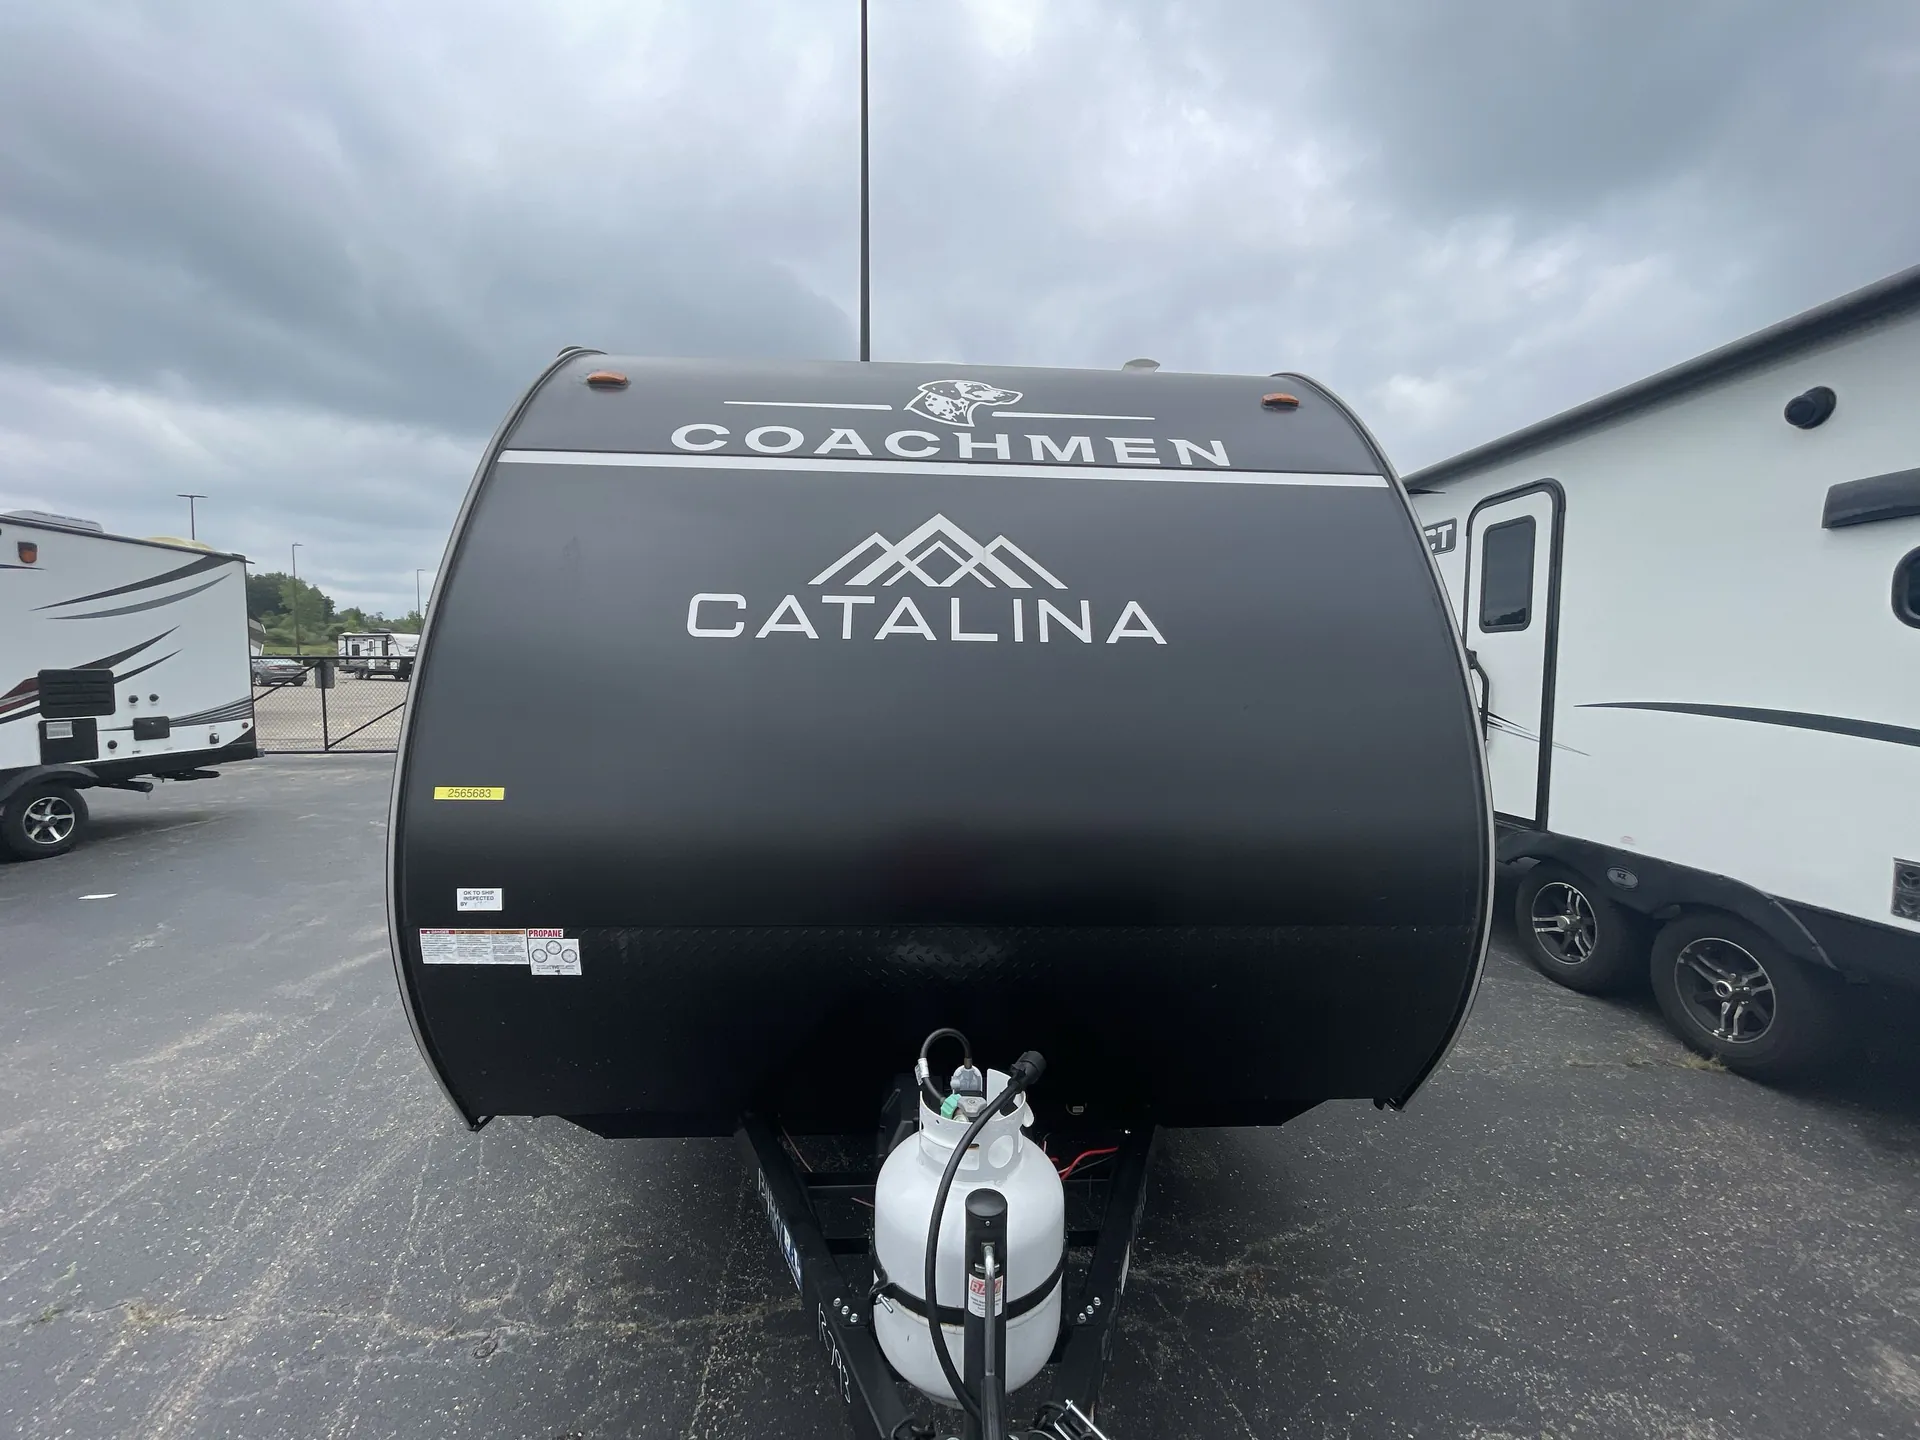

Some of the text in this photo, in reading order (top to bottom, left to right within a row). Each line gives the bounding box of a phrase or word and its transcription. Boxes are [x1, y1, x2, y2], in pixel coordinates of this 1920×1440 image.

[670, 423, 1231, 467] COACHMEN
[686, 592, 1168, 645] CATALINA
[447, 788, 492, 798] 2565683
[528, 929, 562, 938] PROPANE
